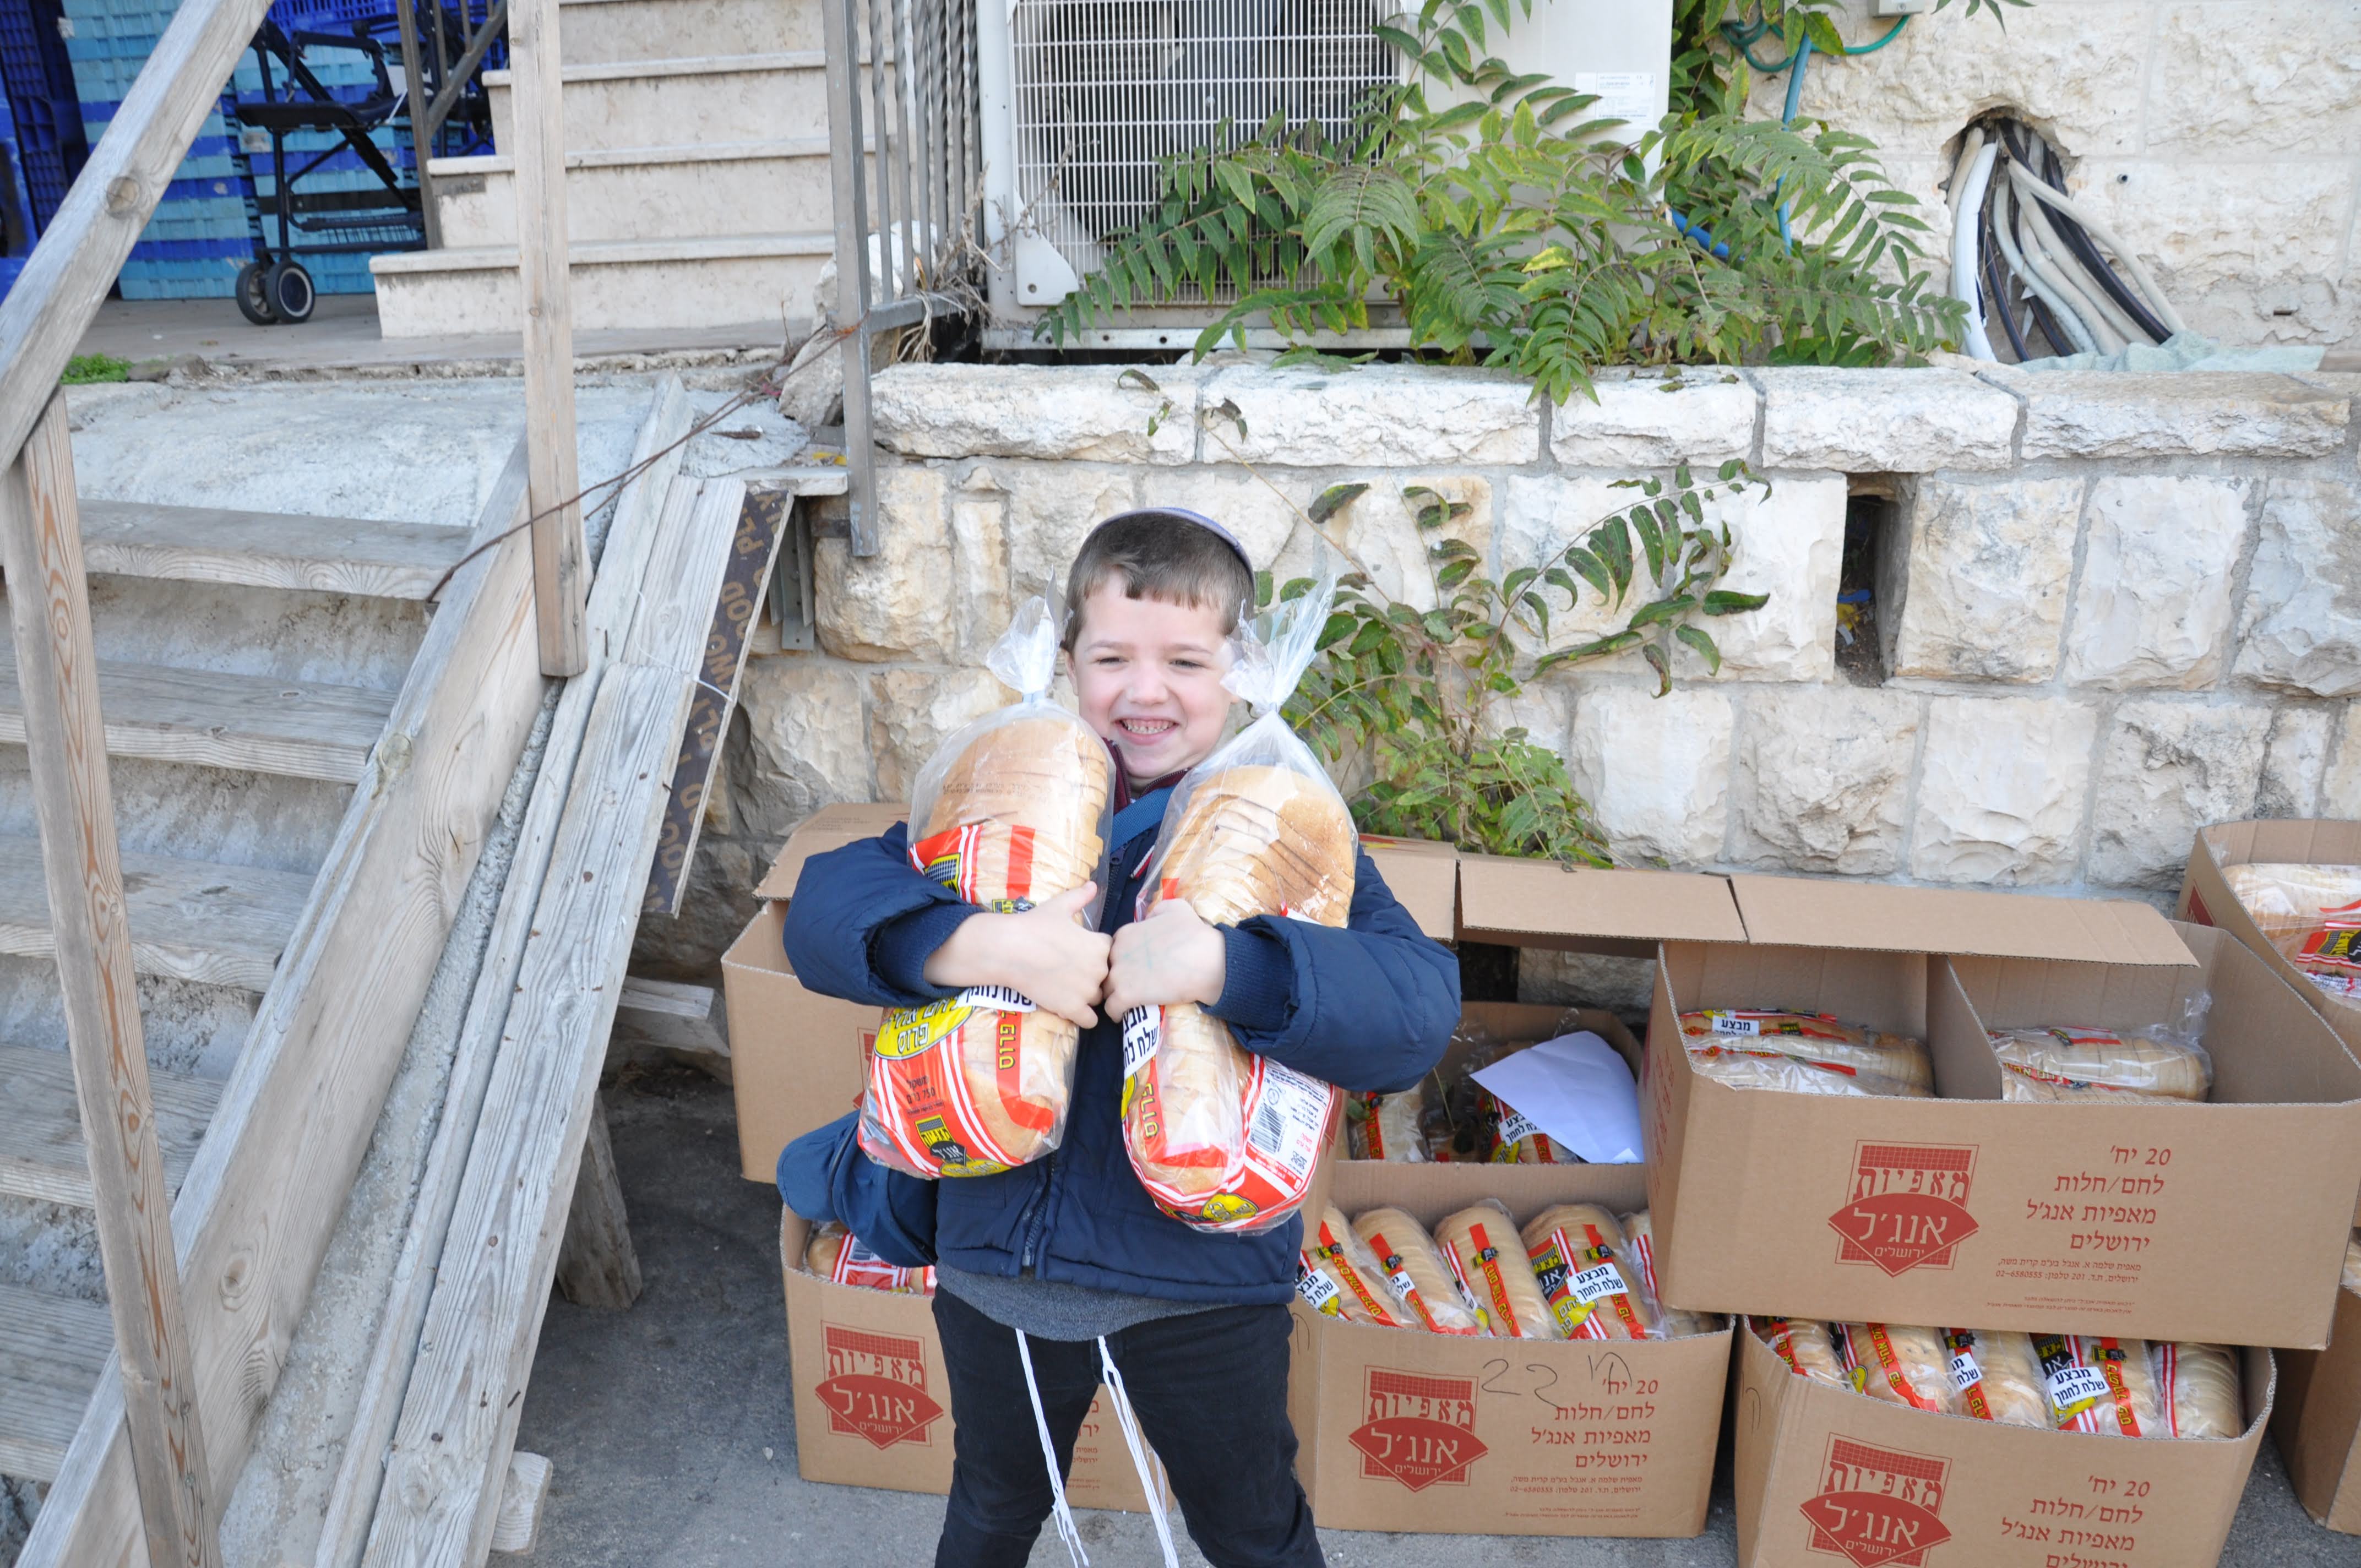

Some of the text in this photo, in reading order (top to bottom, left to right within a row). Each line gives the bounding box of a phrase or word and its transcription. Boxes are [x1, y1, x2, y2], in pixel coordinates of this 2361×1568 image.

[736, 505, 765, 554] PL
[1721, 1018, 1751, 1032] מבצע
[897, 1022, 929, 1054] פרוס
[999, 1024, 1016, 1070] פרוס
[1505, 1124, 1525, 1143] לחמך
[2145, 1147, 2172, 1166] 20
[1853, 1166, 1970, 1211] מאפיות
[2054, 1171, 2164, 1194] לחם/חלות
[2081, 1205, 2156, 1224] מאפיות
[2070, 1231, 2150, 1253] ירושלים
[1874, 1245, 1925, 1259] ירושלים
[1576, 1266, 1609, 1284] מבצע
[1576, 1277, 1624, 1301] שלח לחמך
[829, 1347, 925, 1386] מאפיות
[1956, 1368, 1979, 1386] שלח
[2055, 1368, 2092, 1385] מבצע
[1635, 1379, 1659, 1395] 20
[2054, 1380, 2106, 1405] שלח לחמך
[1368, 1390, 1473, 1431] מאפיות
[1554, 1401, 1655, 1421] לחם/חלות
[859, 1420, 903, 1435] ירושלים
[1583, 1429, 1651, 1445] מאפיות
[1575, 1451, 1647, 1468] ירושלים
[1394, 1463, 1441, 1477] ירושלים
[1824, 1461, 1943, 1515] מאפיות
[2124, 1480, 2151, 1498] 20
[2030, 1497, 2144, 1524] לחם/חלות
[1845, 1540, 1896, 1556] ירושלים
[2058, 1529, 2135, 1551] מאפיות
